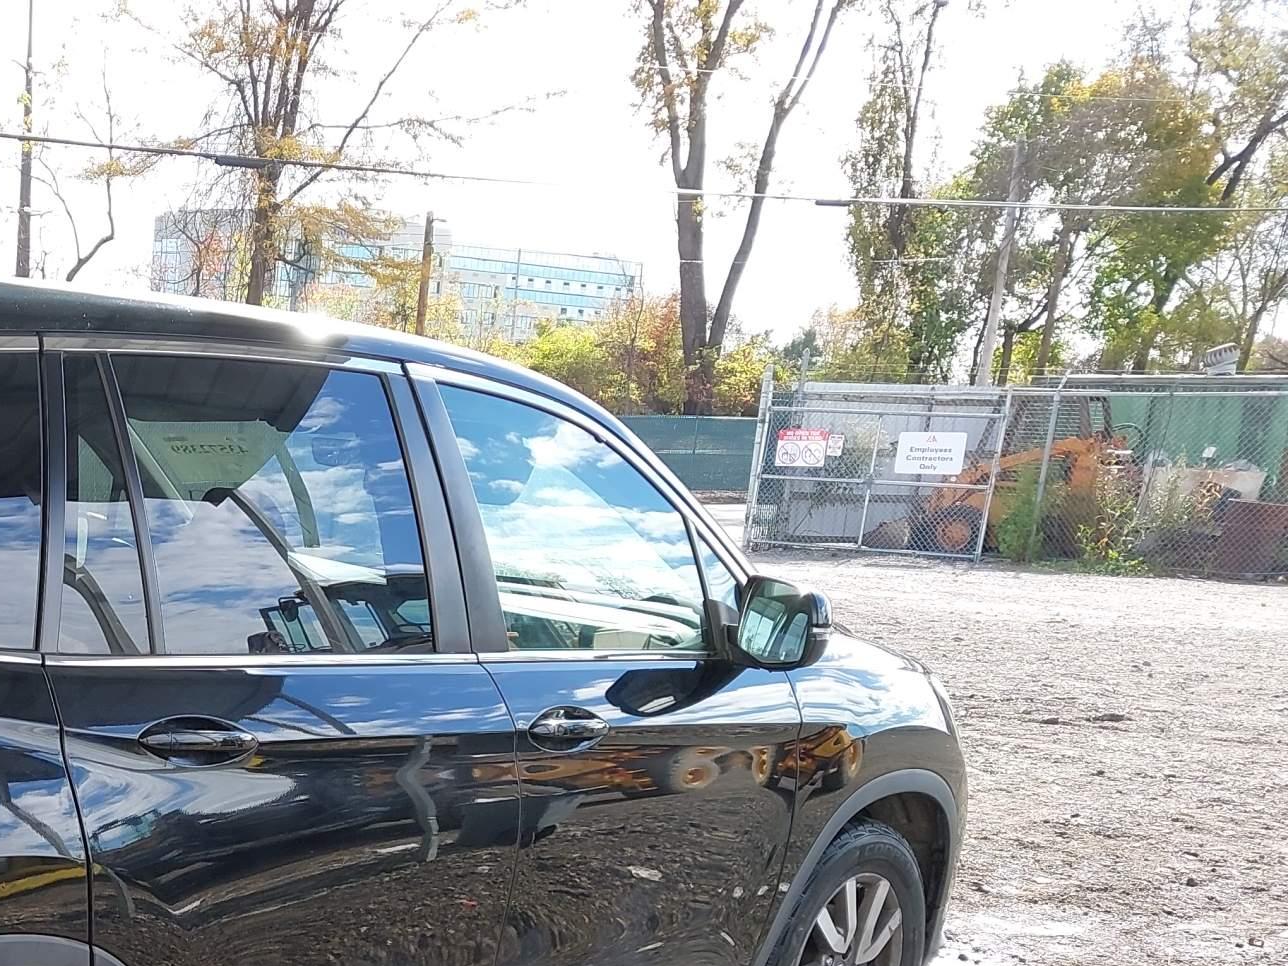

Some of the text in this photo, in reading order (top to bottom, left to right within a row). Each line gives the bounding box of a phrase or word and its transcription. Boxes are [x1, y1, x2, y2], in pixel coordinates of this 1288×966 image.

[909, 446, 953, 454] Employees
[905, 454, 954, 462] Contractors
[919, 463, 937, 471] Only
